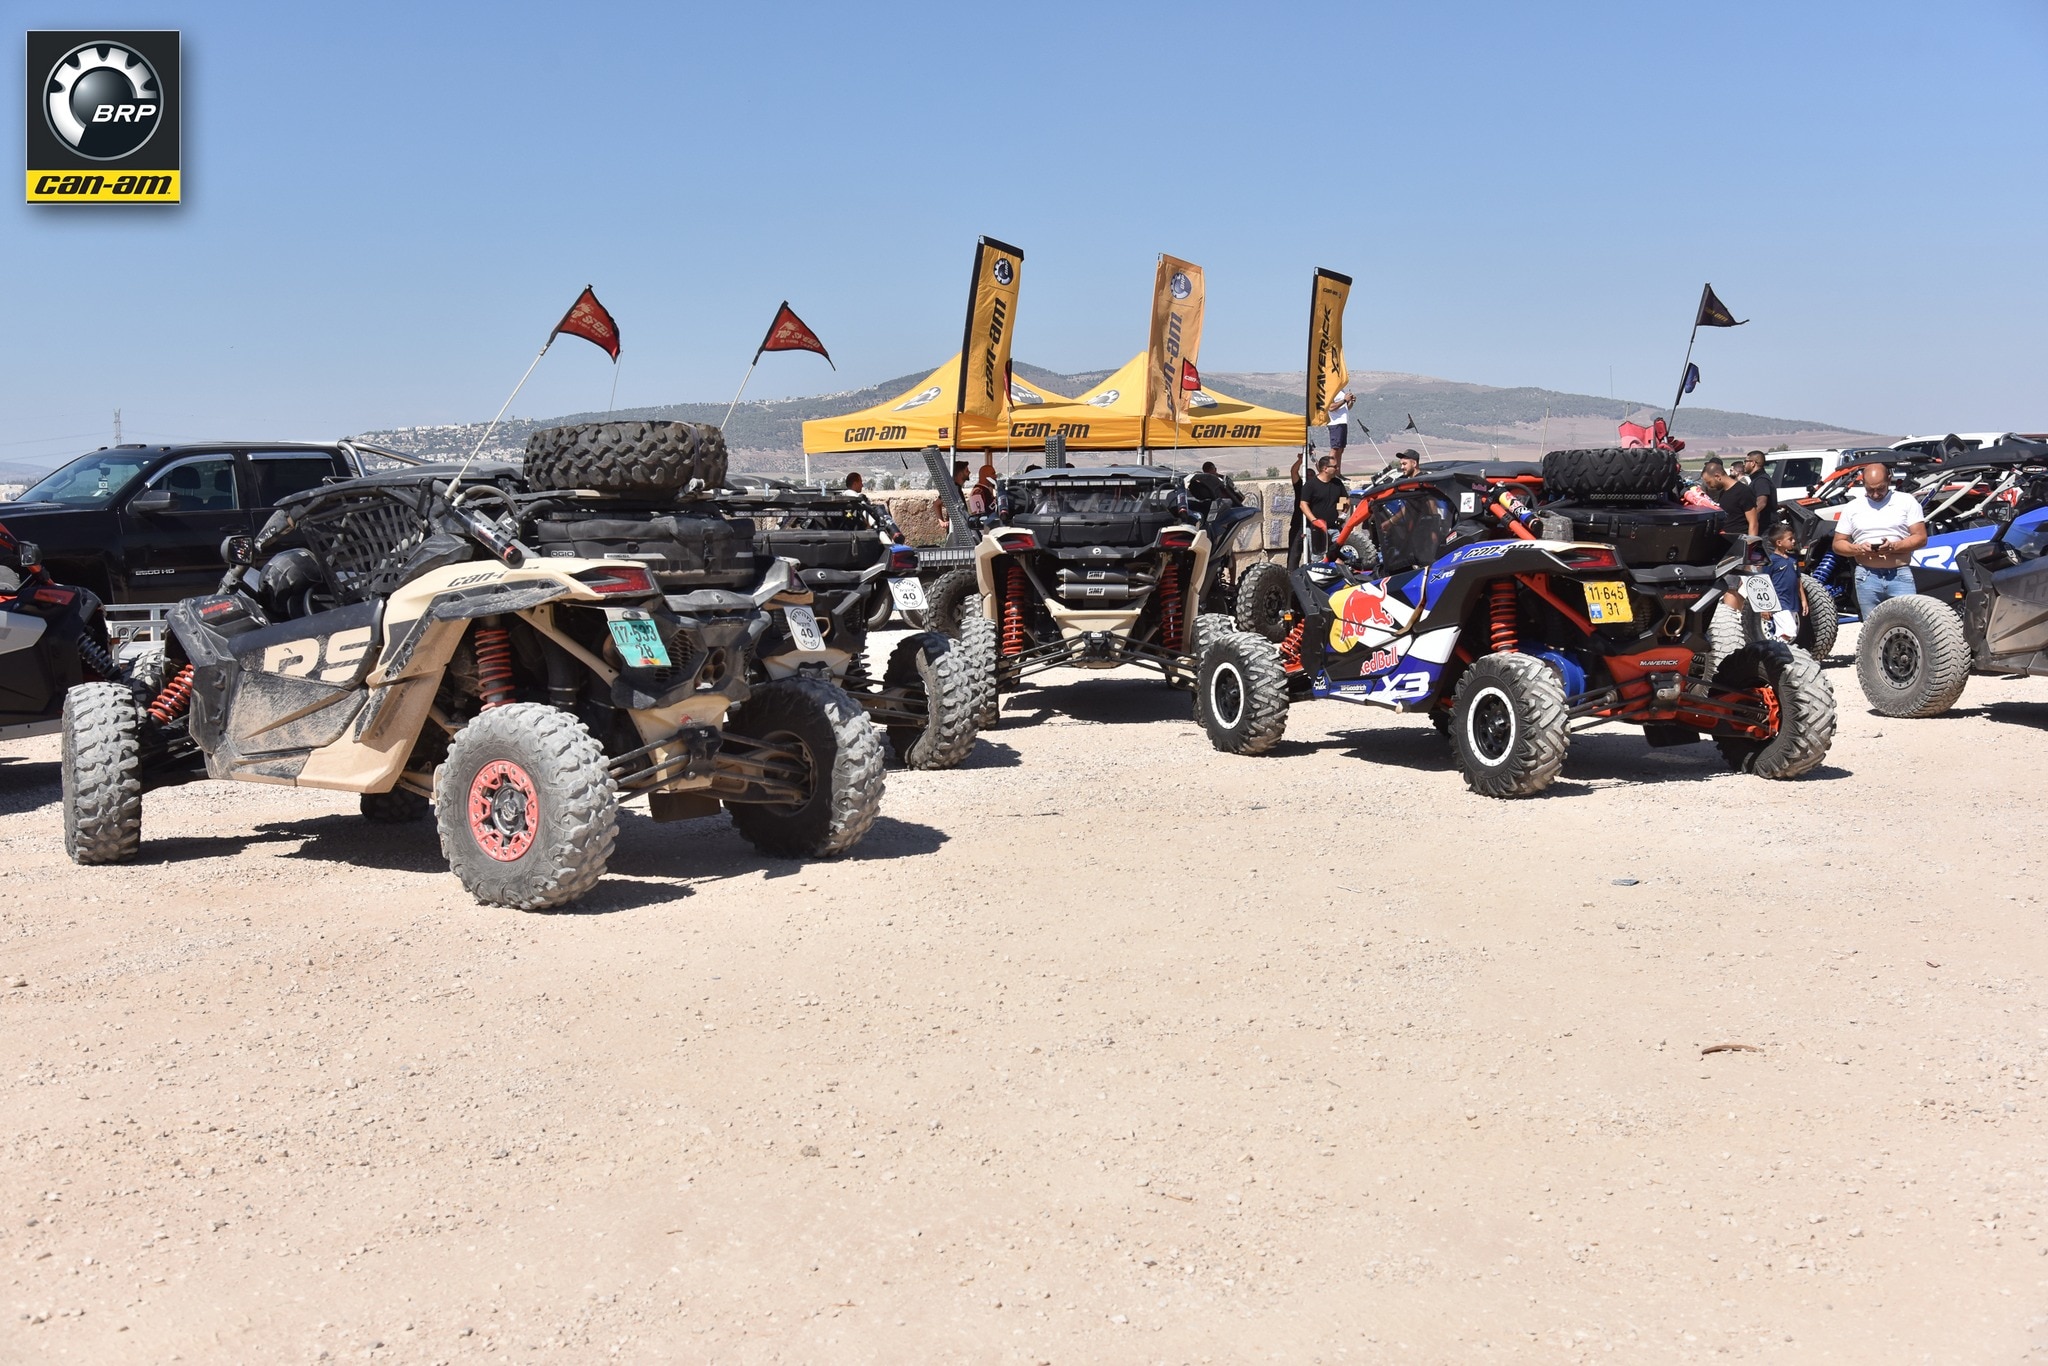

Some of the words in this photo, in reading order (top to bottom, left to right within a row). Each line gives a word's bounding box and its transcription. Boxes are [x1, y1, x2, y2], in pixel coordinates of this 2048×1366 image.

[985, 297, 1006, 402] can-am
[1316, 304, 1331, 411] MAVERICK
[844, 425, 907, 443] can-am
[1010, 422, 1090, 438] can-am
[1190, 423, 1262, 439] can-am
[1757, 592, 1770, 601] 40
[1606, 603, 1620, 616] 31
[800, 628, 814, 639] 40
[1377, 647, 1399, 669] Bull
